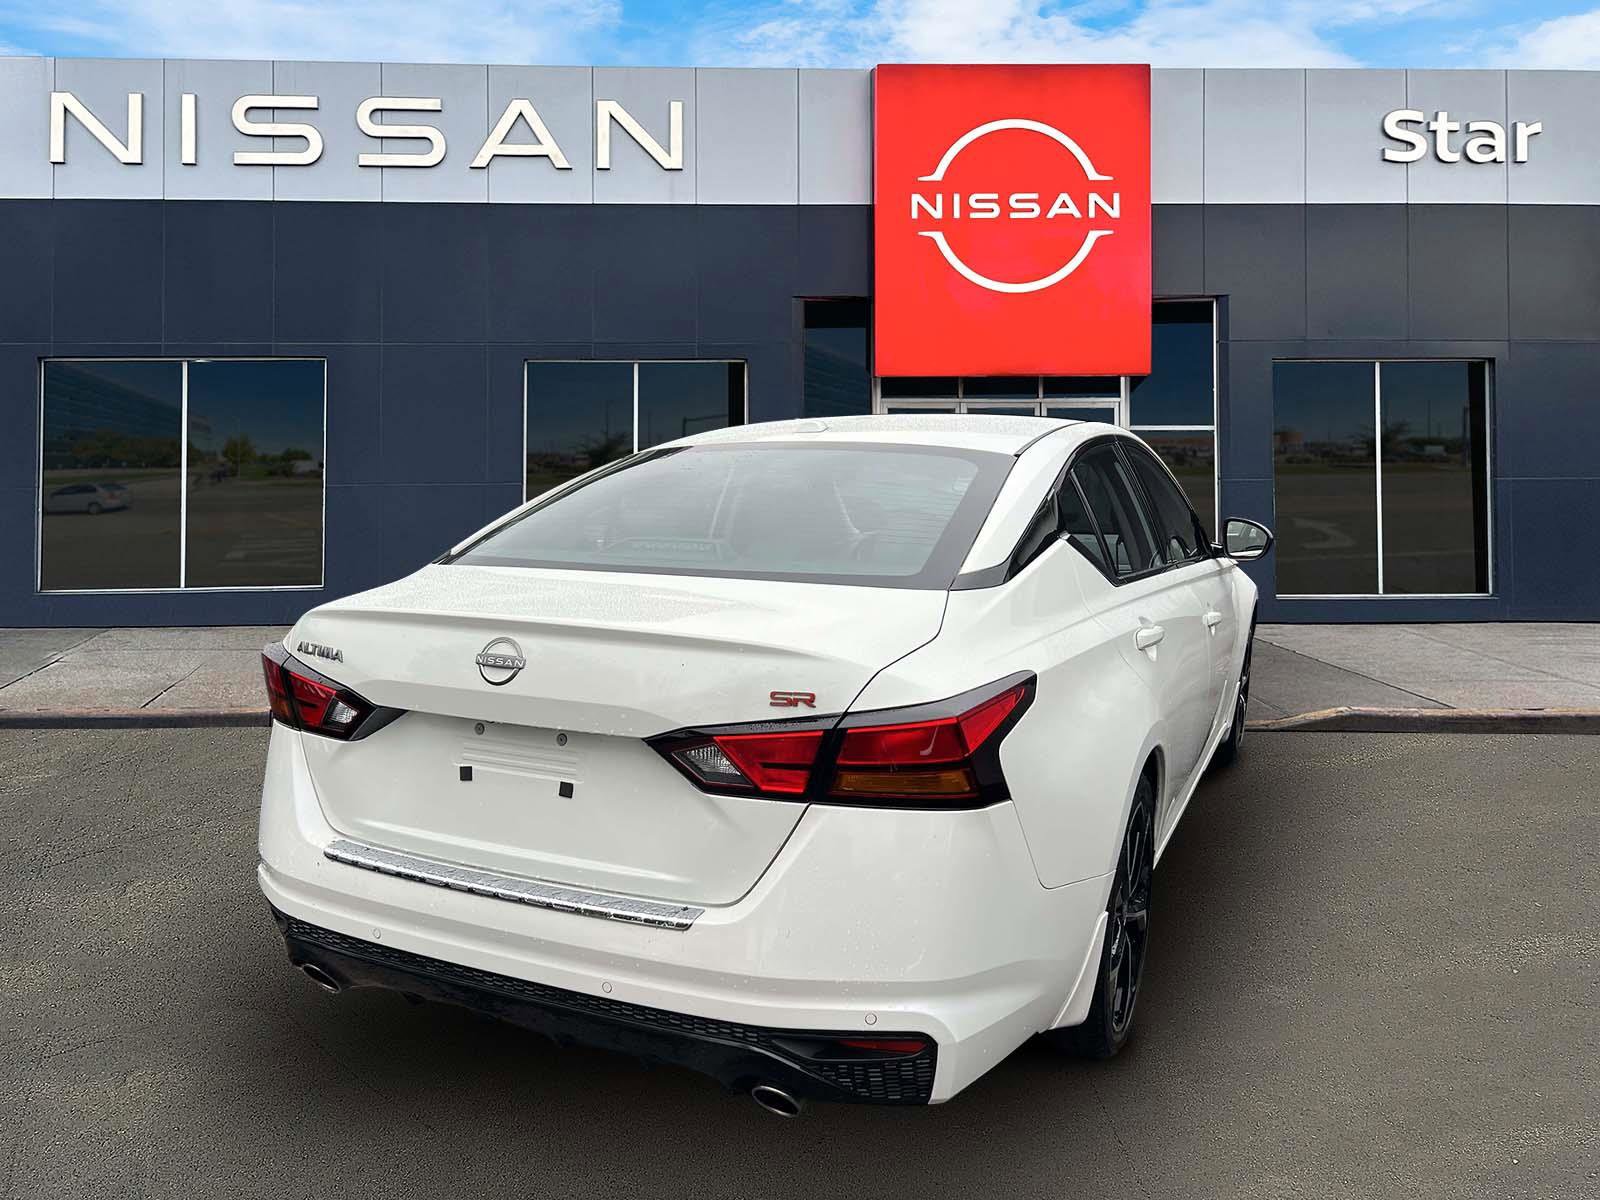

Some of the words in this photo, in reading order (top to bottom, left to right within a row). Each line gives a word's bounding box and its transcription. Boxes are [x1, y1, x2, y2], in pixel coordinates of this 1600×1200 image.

[49, 91, 684, 170] NISSAN
[1381, 108, 1543, 163] Star
[910, 191, 1121, 219] NISSAN
[297, 641, 343, 663] ALTIMA
[477, 655, 524, 667] NISSAN
[769, 690, 816, 708] SR
